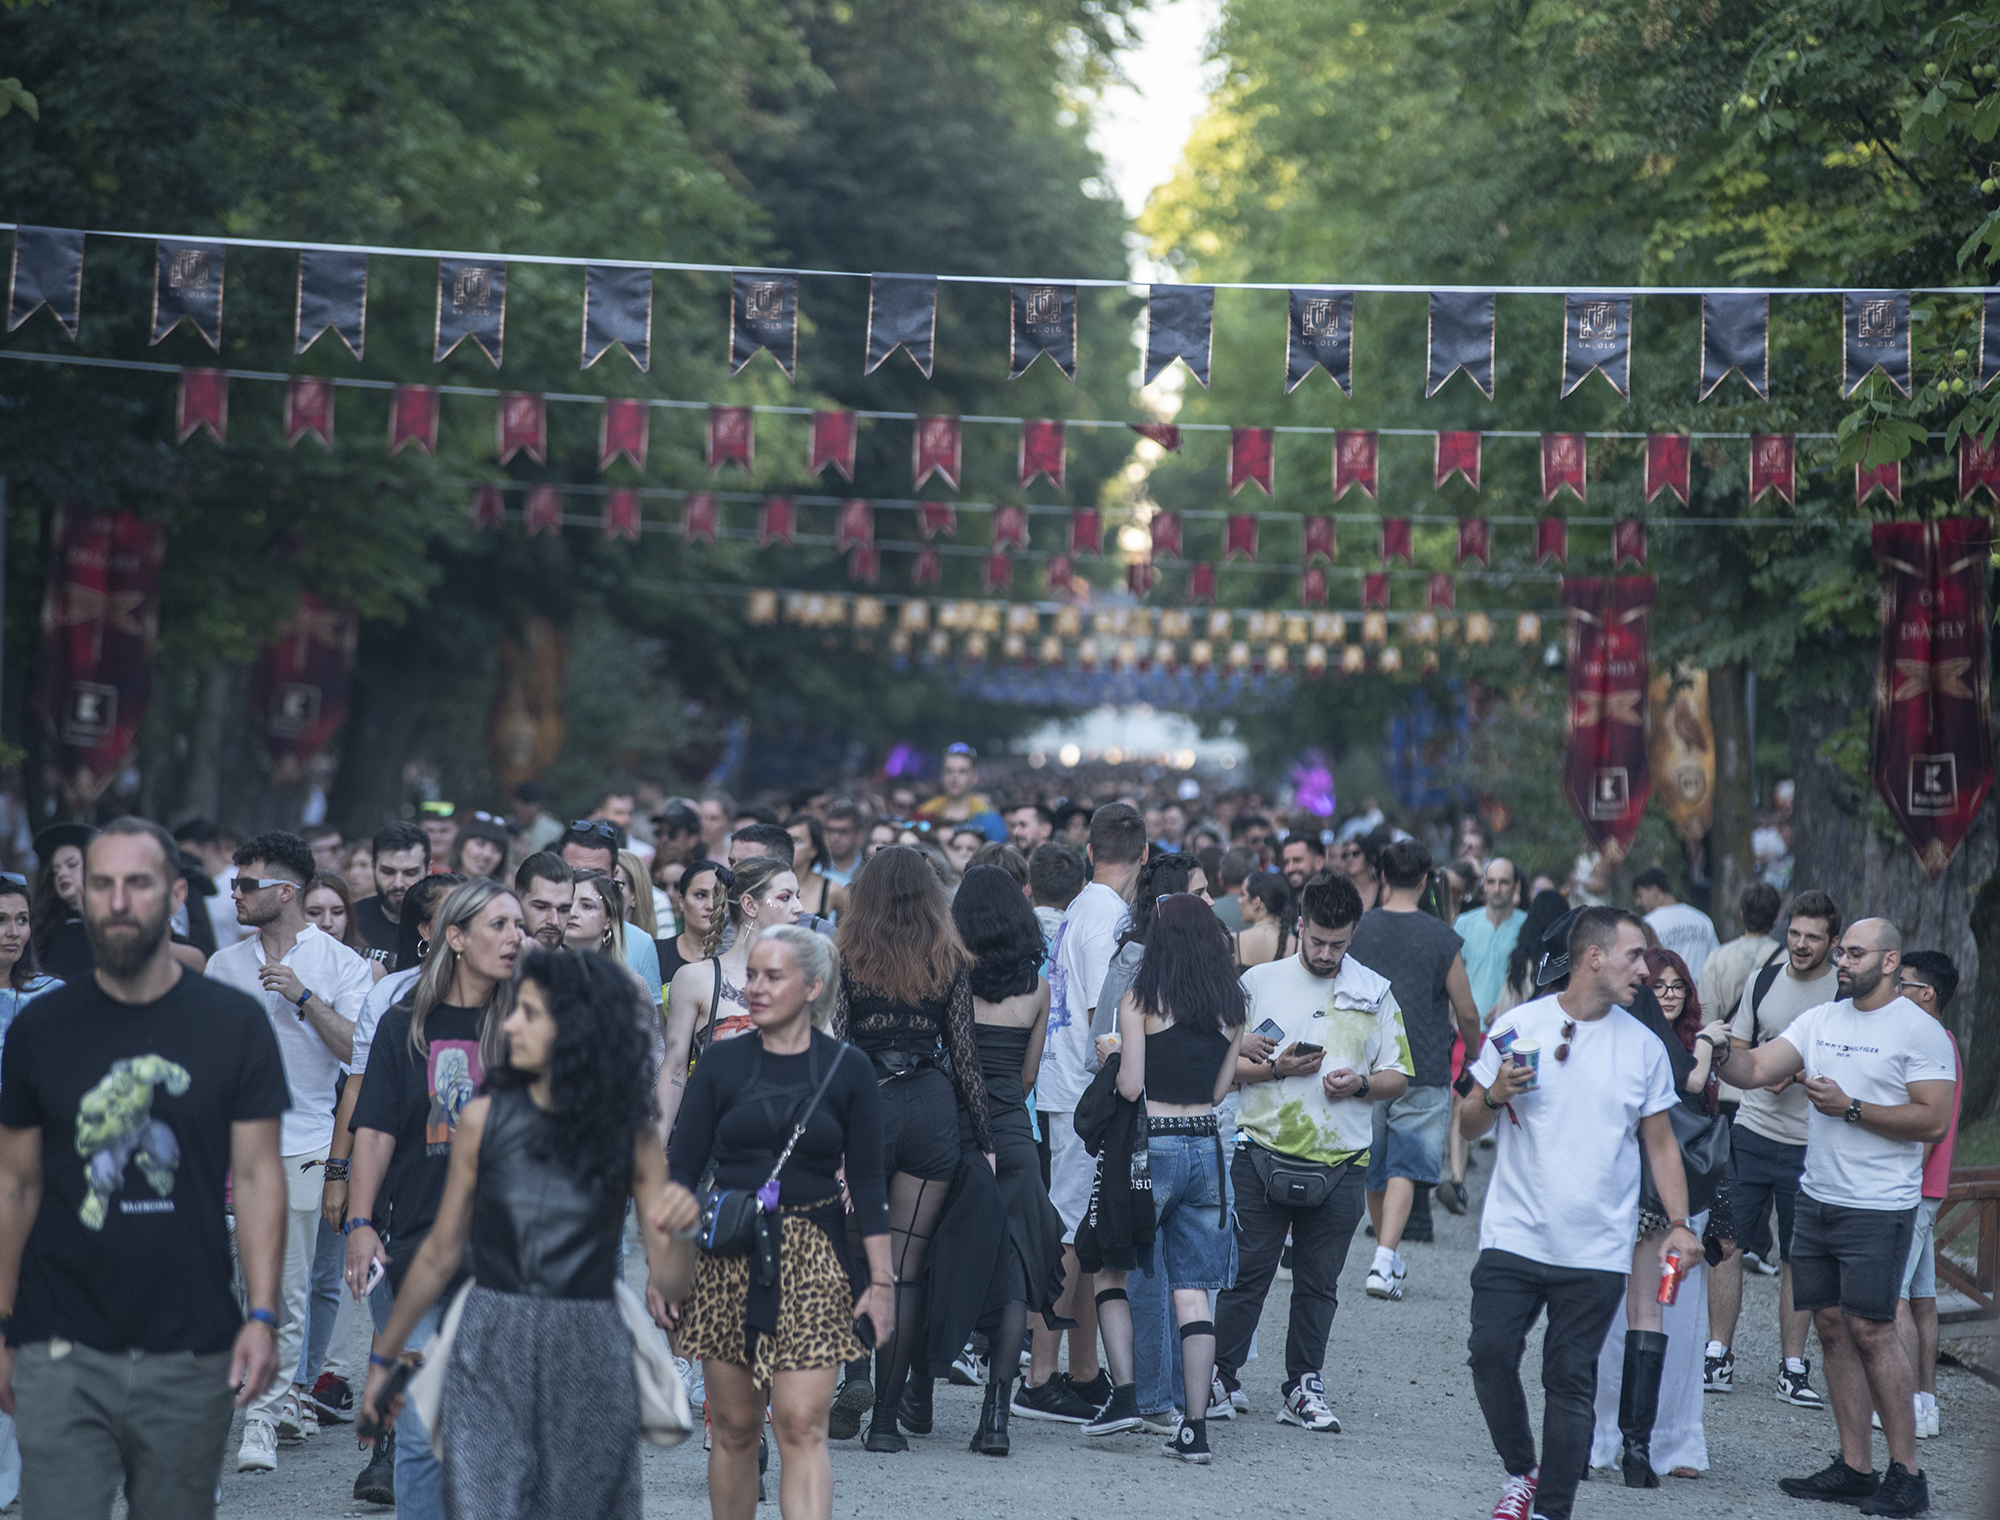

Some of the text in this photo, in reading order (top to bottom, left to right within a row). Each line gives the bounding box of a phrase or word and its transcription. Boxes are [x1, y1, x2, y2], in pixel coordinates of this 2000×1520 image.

[453, 308, 490, 317] UNOLD
[1026, 326, 1062, 334] UNOLD
[1302, 339, 1338, 347] UNOLD
[1578, 341, 1616, 350] UNOLD
[1858, 340, 1896, 348] UNOLD
[1816, 1039, 1880, 1054] TOMMY HILFIGER
